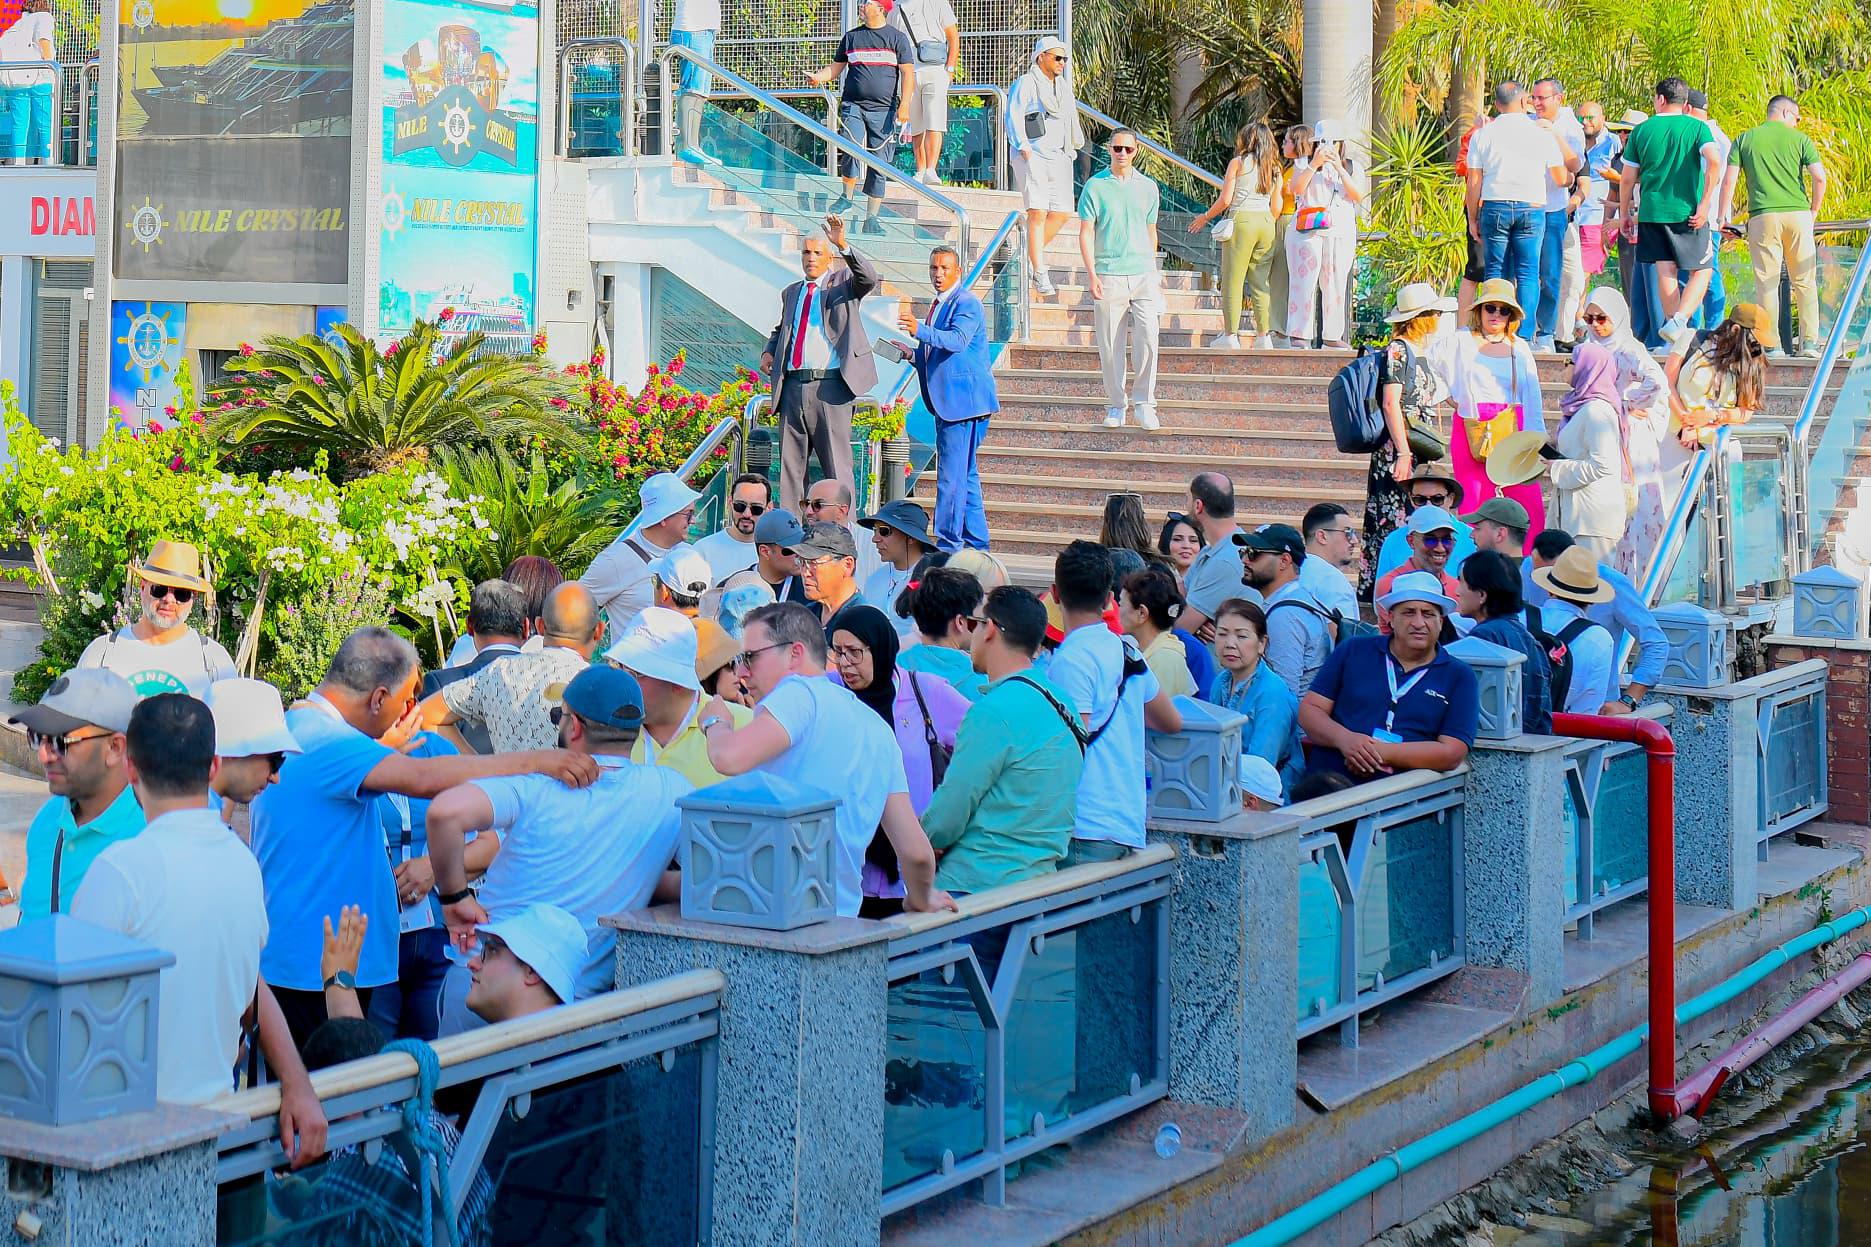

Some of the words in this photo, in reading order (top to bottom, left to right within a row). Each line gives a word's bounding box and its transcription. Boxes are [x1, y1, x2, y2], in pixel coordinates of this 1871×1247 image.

[397, 115, 427, 140] NILE
[485, 119, 516, 152] CRYSTAL
[174, 209, 232, 233] NILE
[235, 207, 345, 232] CRYSTAL
[411, 198, 452, 223] NILE
[453, 199, 525, 226] CRYSTAL
